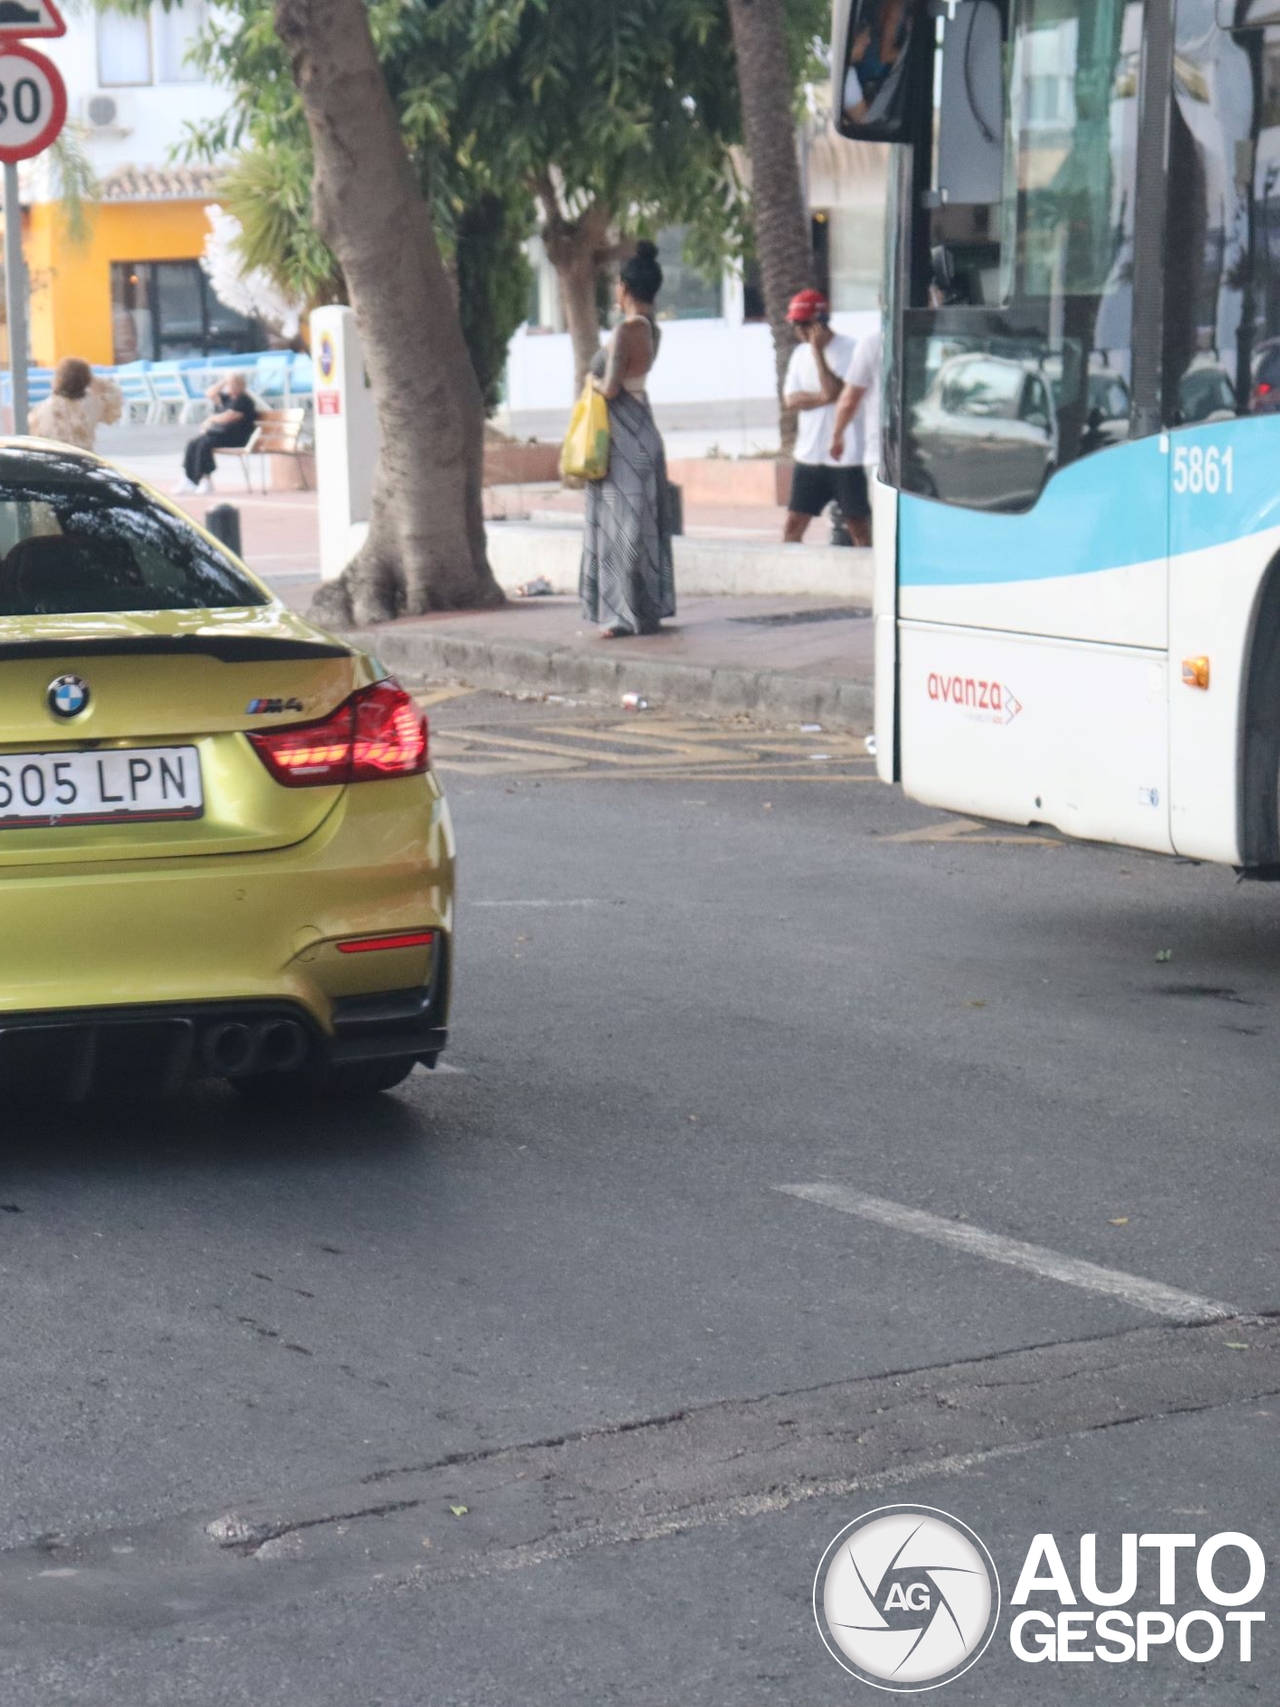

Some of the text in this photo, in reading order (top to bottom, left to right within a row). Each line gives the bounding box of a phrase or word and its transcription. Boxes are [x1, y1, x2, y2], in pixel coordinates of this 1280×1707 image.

[1173, 445, 1233, 494] 5861
[928, 673, 1002, 711] avanza
[98, 756, 186, 803] LPN
